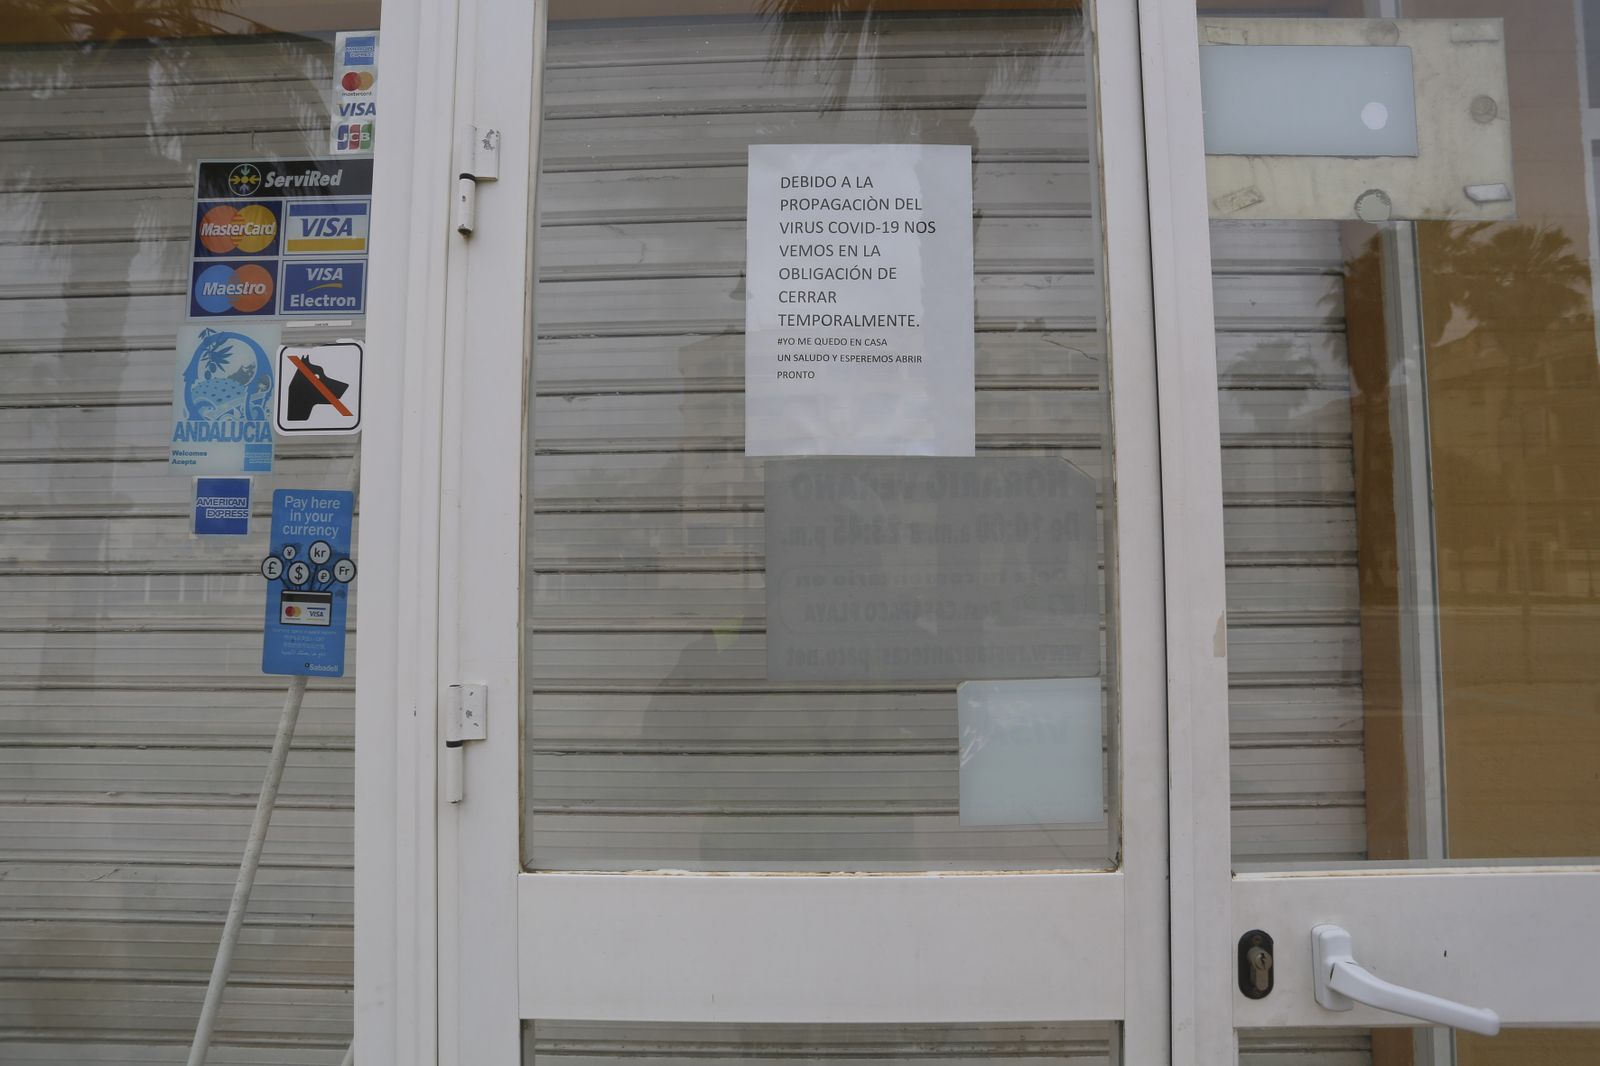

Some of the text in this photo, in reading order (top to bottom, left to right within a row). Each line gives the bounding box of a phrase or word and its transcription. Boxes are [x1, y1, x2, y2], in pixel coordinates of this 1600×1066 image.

[338, 102, 376, 117] VISA
[264, 169, 343, 188] ServiRed
[780, 175, 874, 189] DEBIDO A LA
[895, 197, 923, 211] DEL
[201, 222, 276, 237] MasterCard
[300, 217, 353, 238] VISA
[780, 220, 936, 235] VIRUS COVID-19 NOS
[779, 244, 881, 258] VEMOS EN LA
[305, 267, 343, 281] VISA
[779, 264, 897, 281] OBLIGACIÓN DE
[202, 281, 267, 296] Maestro
[289, 293, 356, 308] Electron
[778, 290, 837, 304] CERRAR
[778, 313, 921, 328] TEMPORALMENTE.
[777, 337, 888, 348] #YO ME QUEDO EN CASA
[777, 354, 922, 364] UN SALUDO Y ESPEREMOS ABRIR
[777, 370, 815, 380] PRONTO
[171, 449, 208, 457] Welcomes
[171, 458, 197, 466] Acepta
[196, 497, 247, 507] AMERICAN
[284, 495, 341, 512] Pay here
[205, 508, 249, 518] EXPRESS
[290, 510, 334, 524] in your
[282, 524, 339, 540] currency
[339, 566, 350, 576] Fr
[309, 610, 324, 618] VISA
